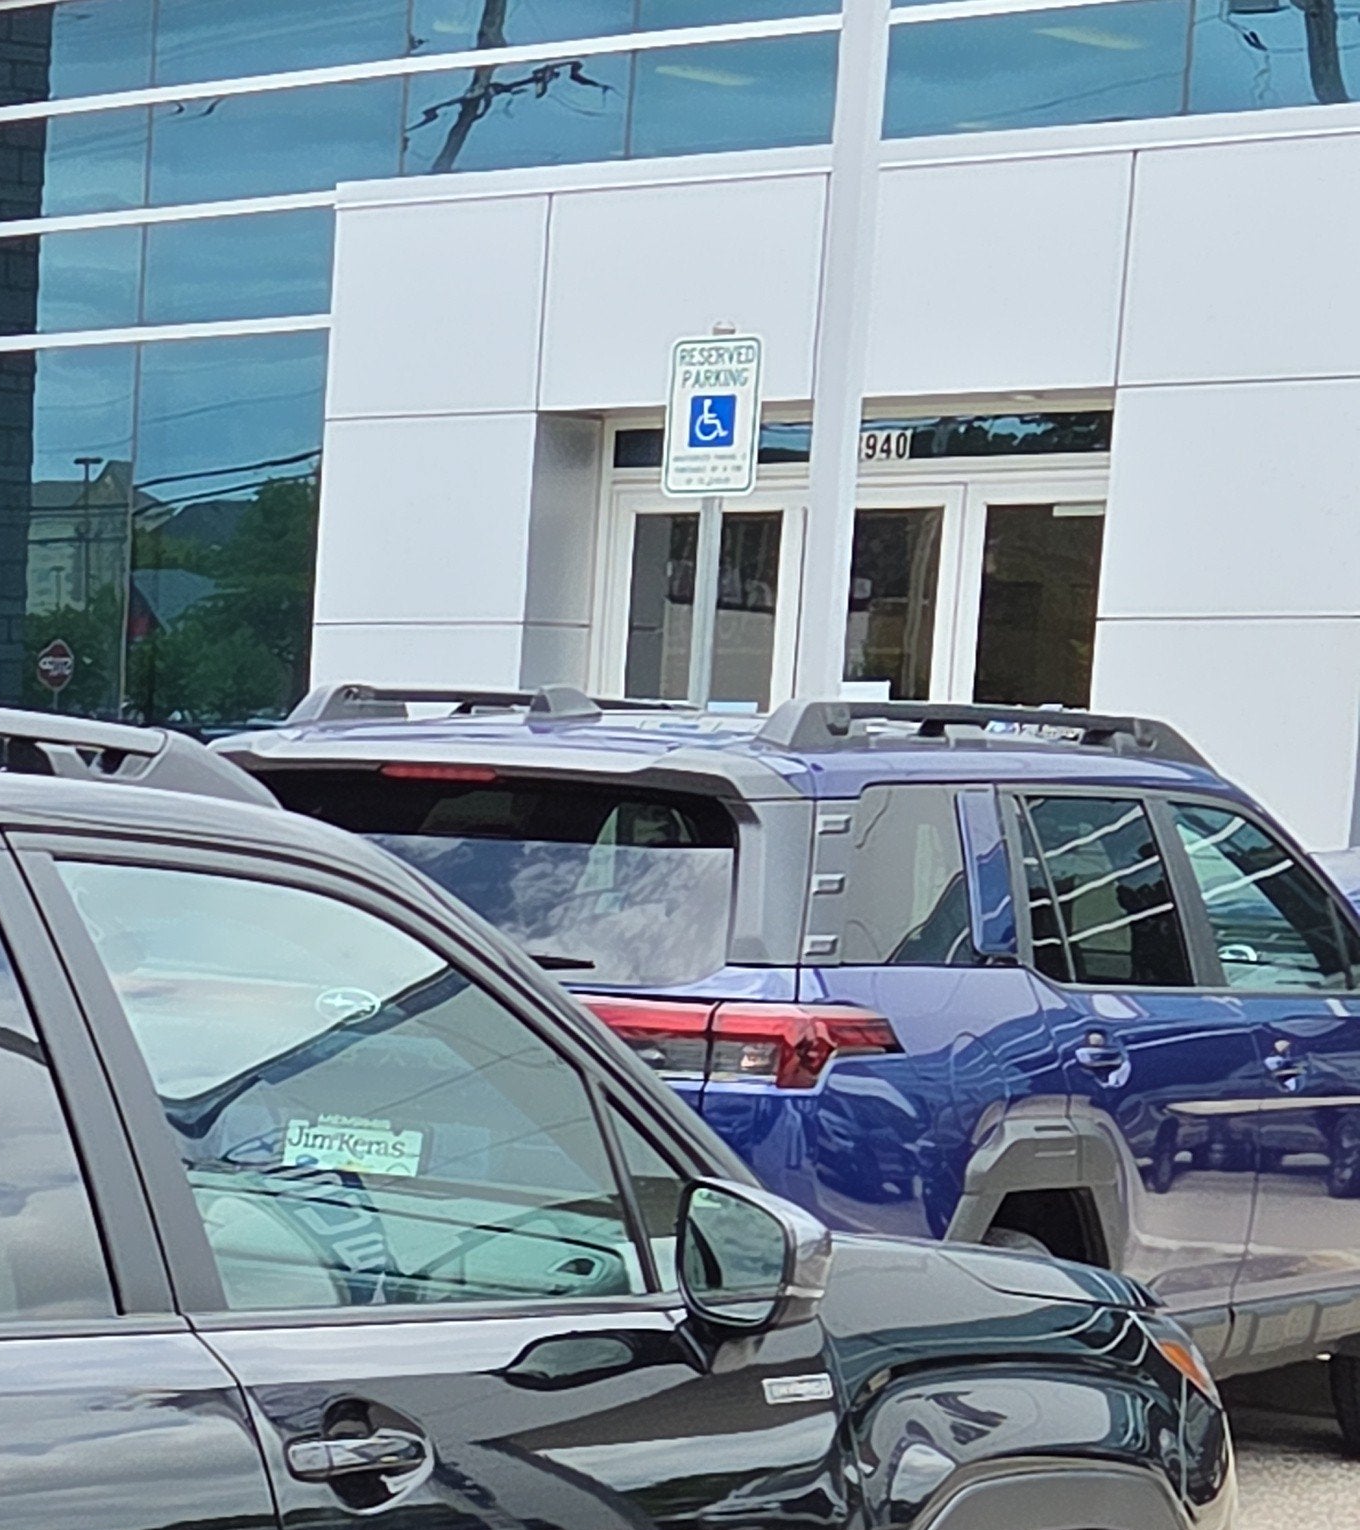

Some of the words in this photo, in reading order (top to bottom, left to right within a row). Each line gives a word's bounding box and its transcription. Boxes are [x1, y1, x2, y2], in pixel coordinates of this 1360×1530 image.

[679, 344, 755, 367] RESERVED
[681, 368, 750, 388] PARKING
[859, 431, 908, 459] 940
